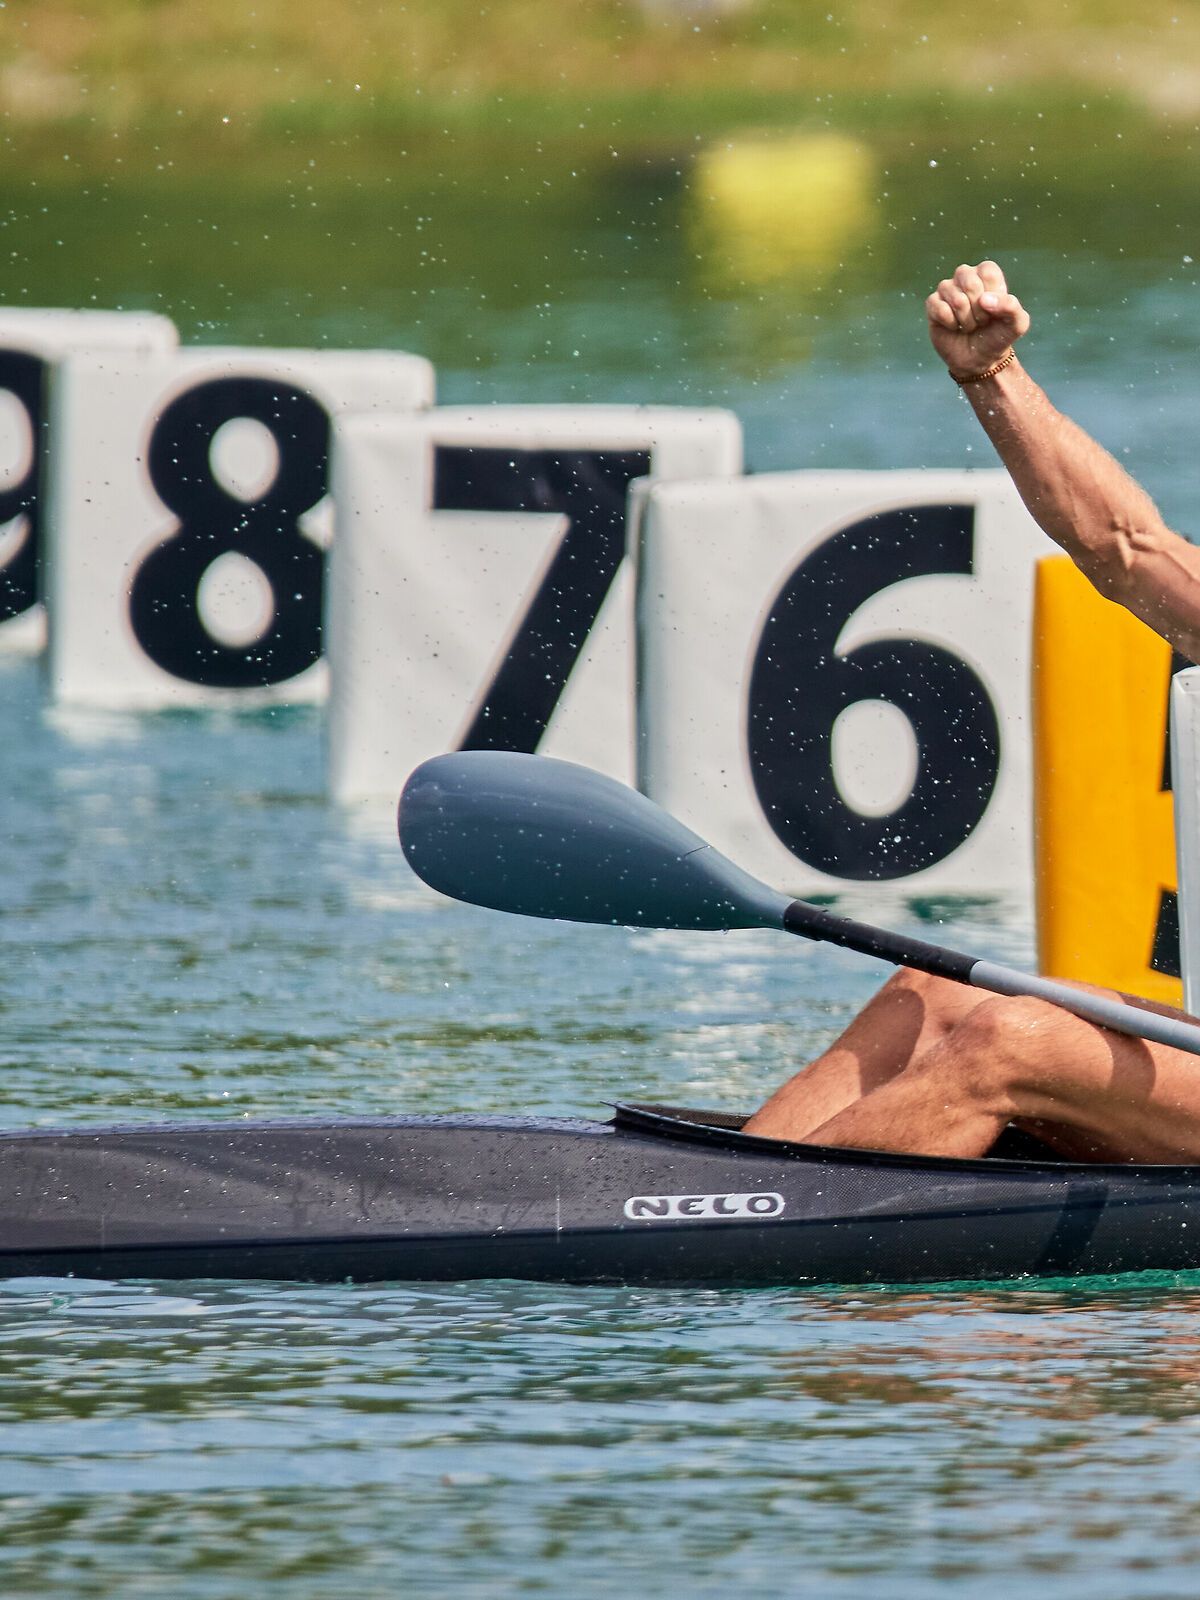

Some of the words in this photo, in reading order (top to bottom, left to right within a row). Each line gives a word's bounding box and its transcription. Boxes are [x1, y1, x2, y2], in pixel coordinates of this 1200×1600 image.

[130, 376, 331, 687] 8
[433, 448, 651, 752] 7
[747, 504, 1000, 881] 6
[631, 1195, 779, 1216] NELO
